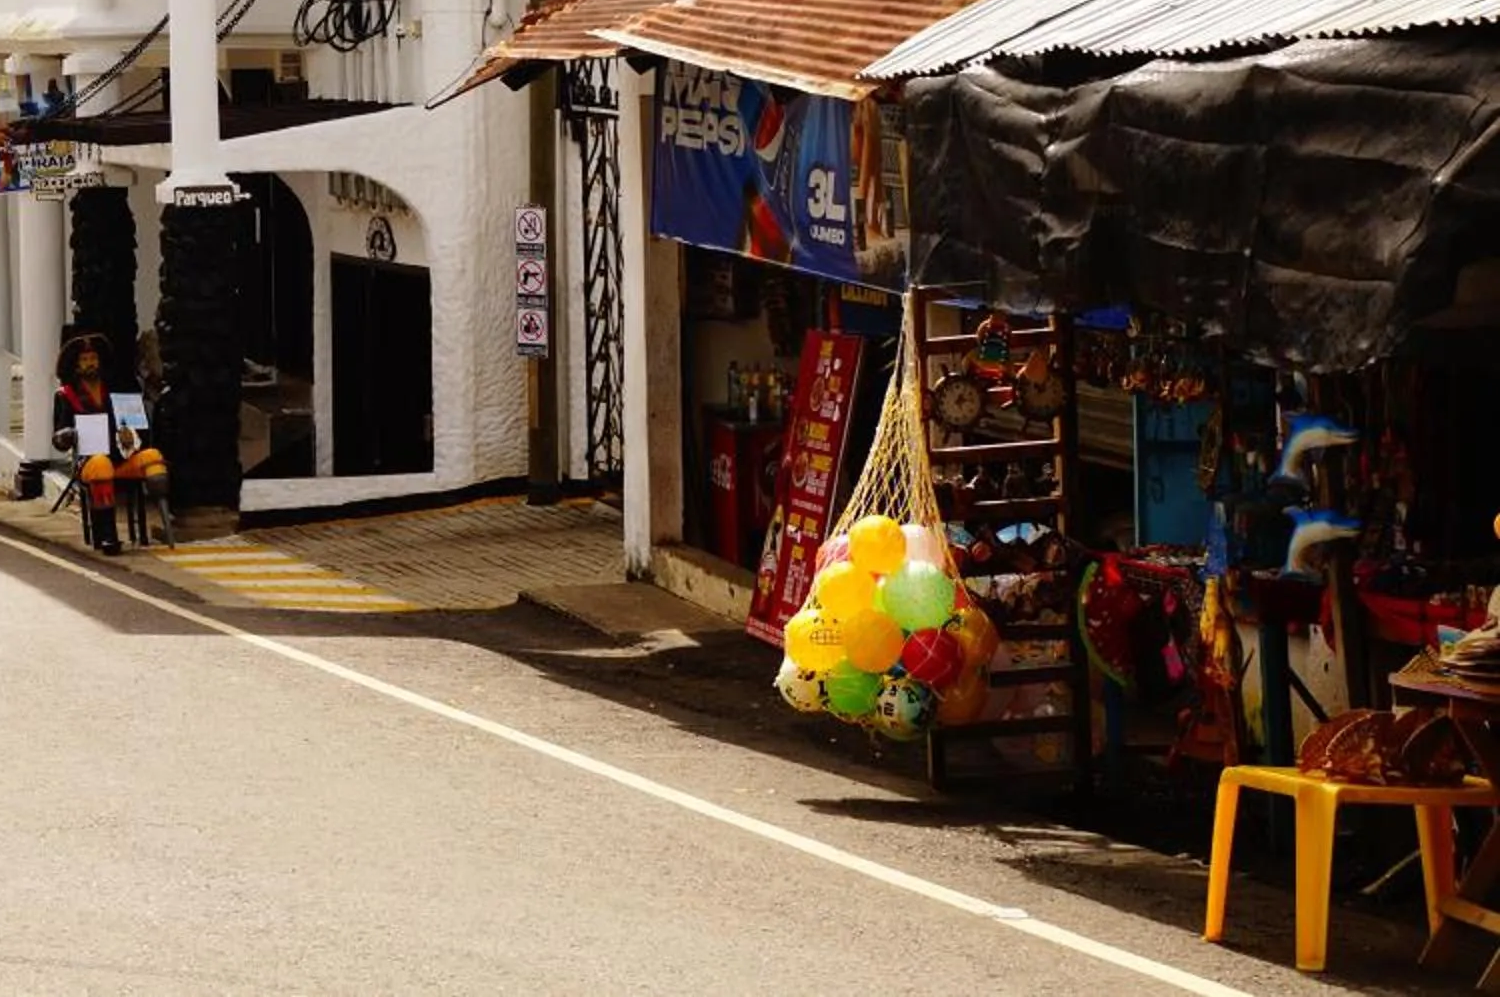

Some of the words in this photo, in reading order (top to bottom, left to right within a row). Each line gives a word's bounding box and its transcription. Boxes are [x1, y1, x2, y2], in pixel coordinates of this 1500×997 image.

[661, 106, 745, 158] PEPSI
[175, 190, 232, 208] Parqueo
[807, 168, 846, 222] 3L
